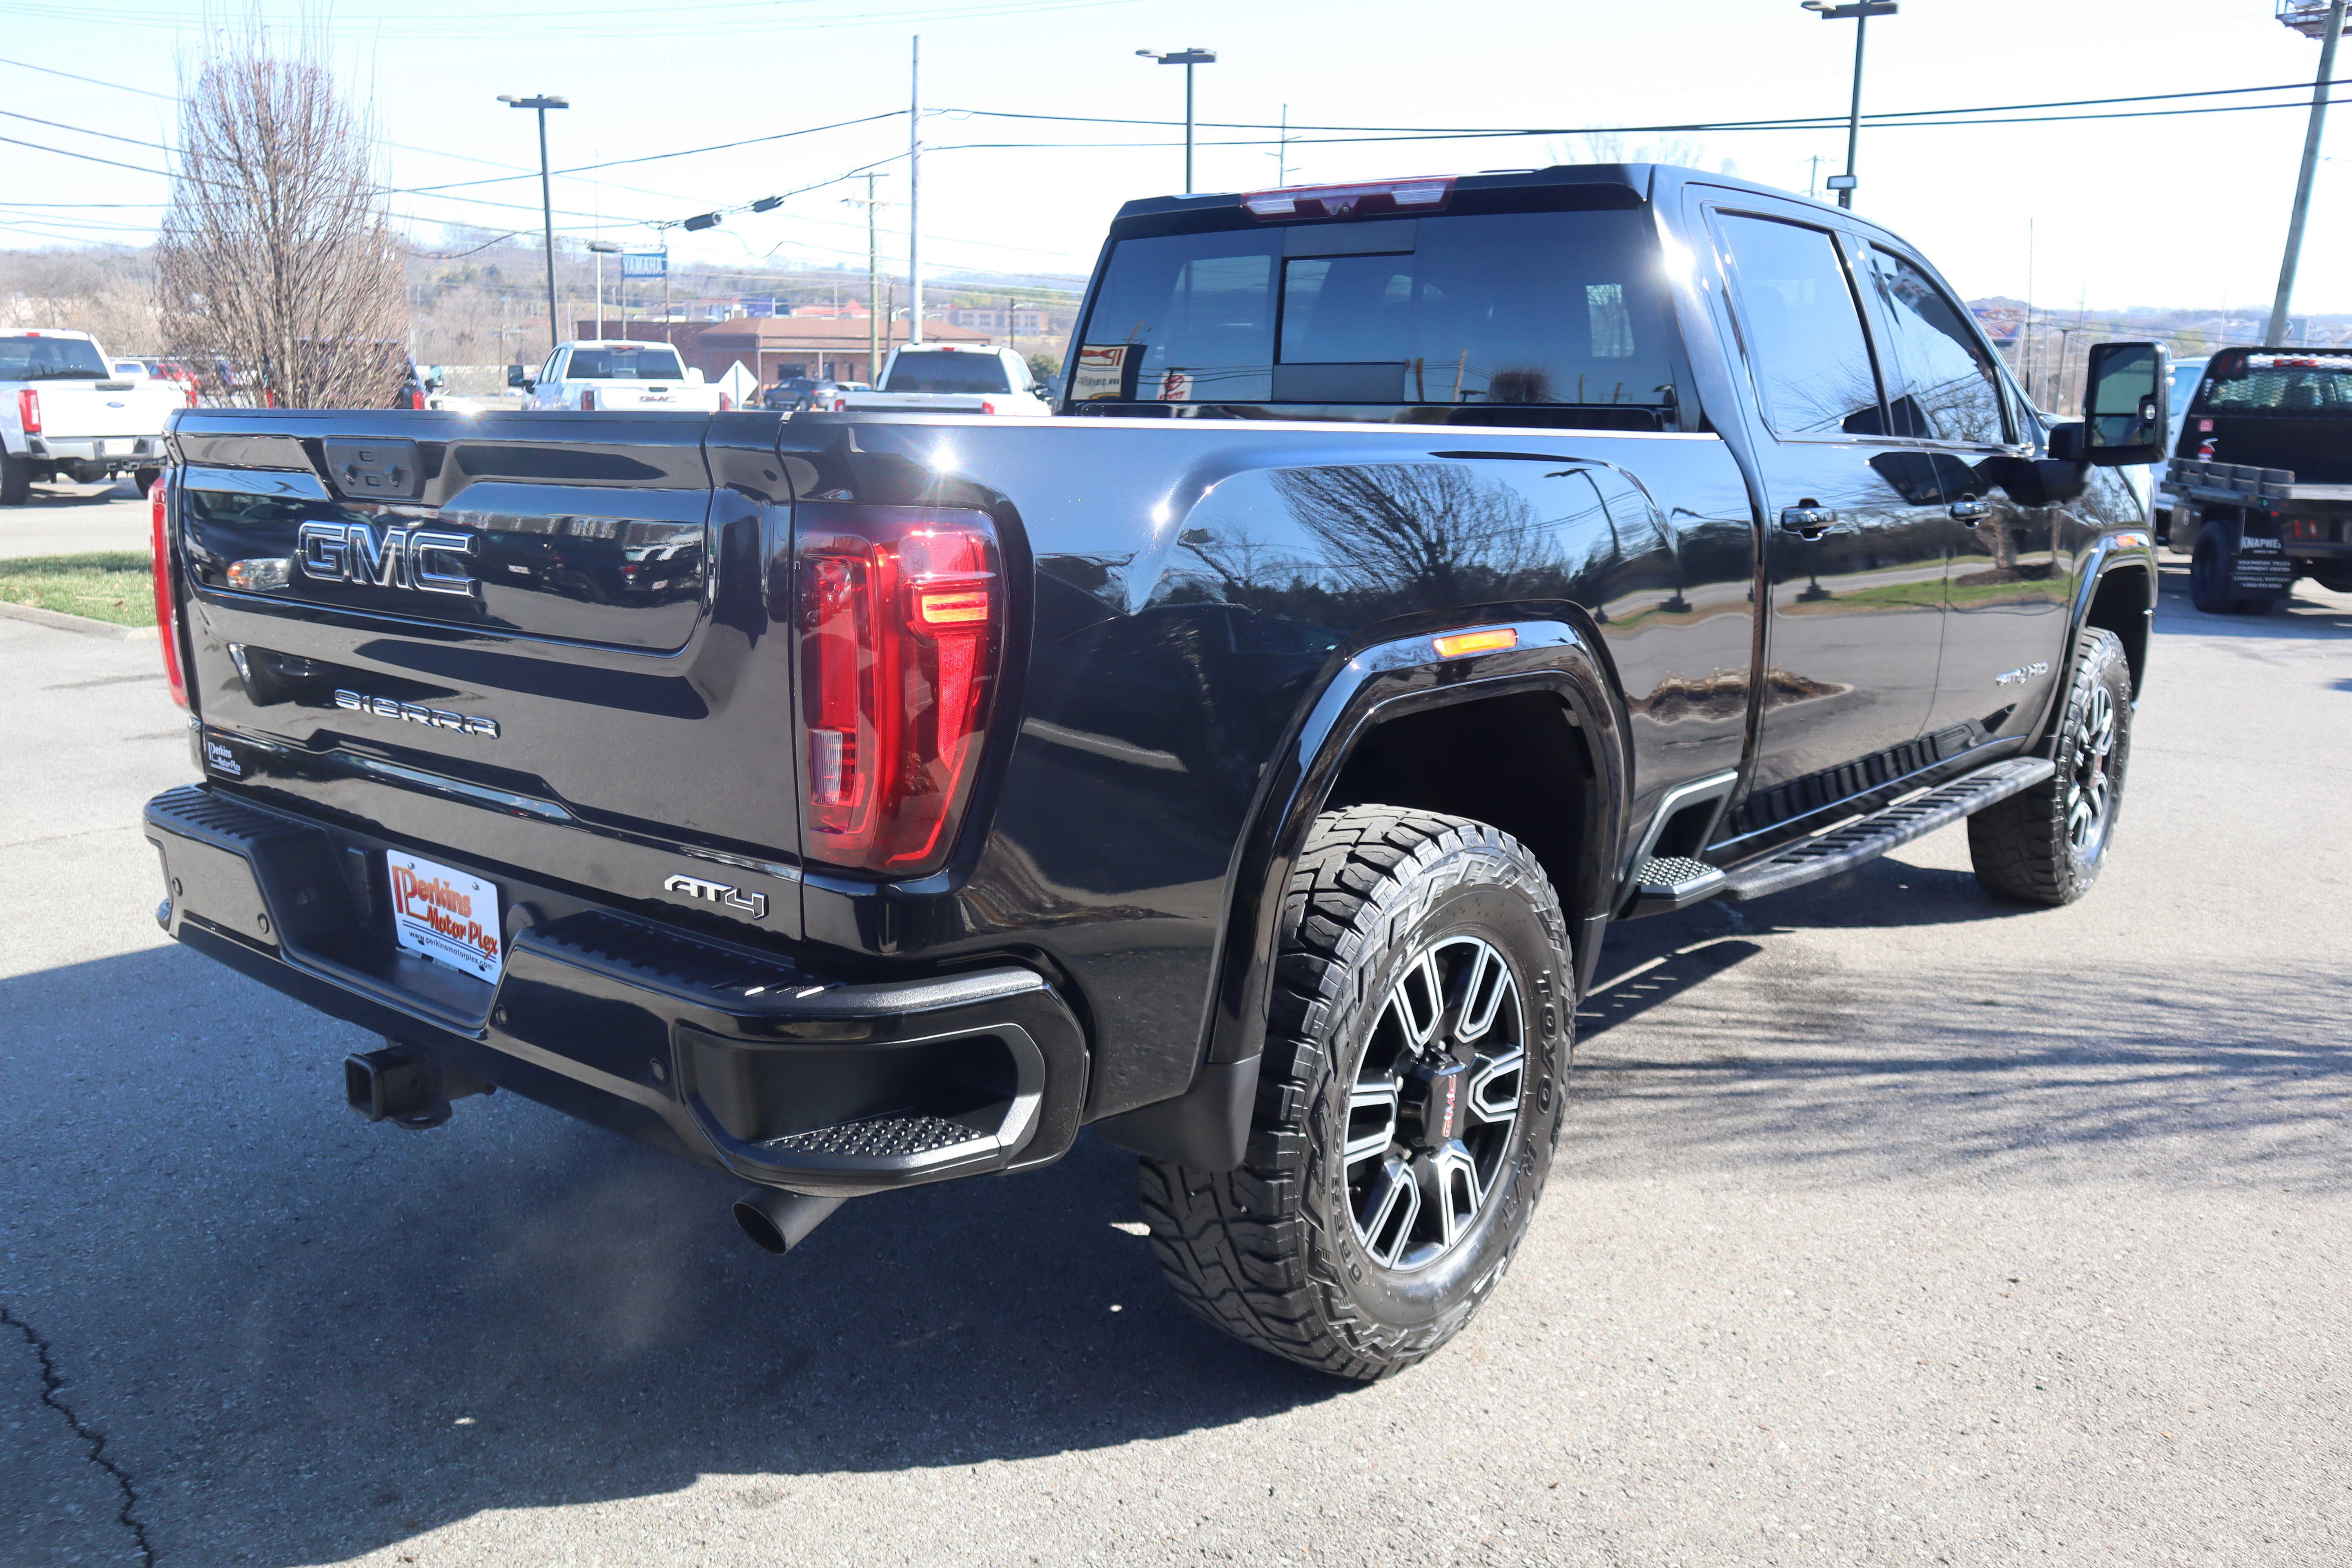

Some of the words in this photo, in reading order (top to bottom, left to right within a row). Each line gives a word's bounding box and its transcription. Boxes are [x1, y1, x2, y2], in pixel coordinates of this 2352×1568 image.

[299, 520, 482, 597] GMC
[335, 689, 501, 739] SIERRA
[208, 742, 232, 760] Perkins
[392, 865, 472, 918] Perkins
[664, 874, 769, 920] AT4
[409, 931, 493, 971] www.perkinsmotorplex.com
[428, 905, 467, 939] Motor
[468, 920, 498, 960] Plex
[1536, 969, 1557, 1116] TOYO
[1442, 1074, 1457, 1138] GMC
